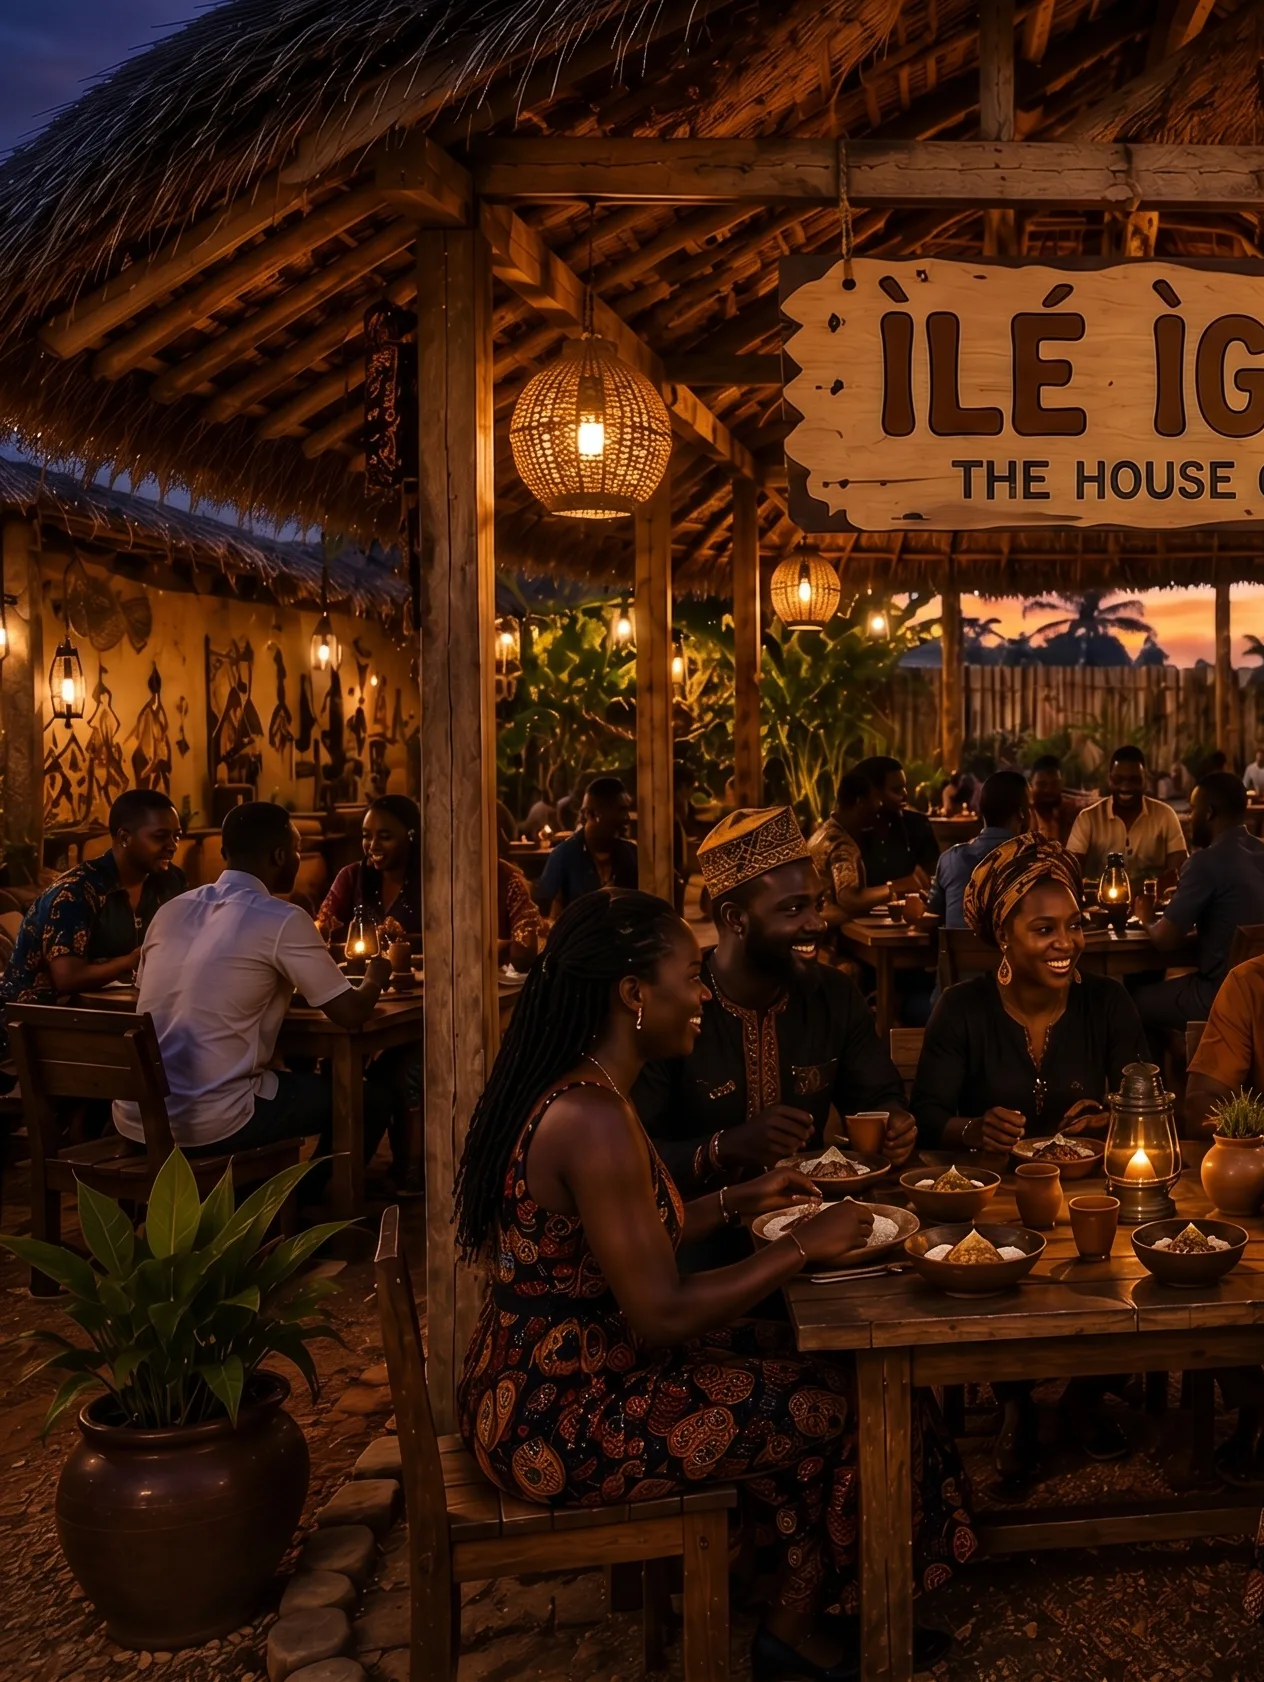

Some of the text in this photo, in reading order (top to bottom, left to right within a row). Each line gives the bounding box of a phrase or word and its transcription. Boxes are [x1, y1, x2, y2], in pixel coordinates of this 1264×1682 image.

[877, 274, 1088, 438] ÌLÉ
[951, 459, 1051, 500] THE
[1076, 459, 1237, 501] HOUSE
